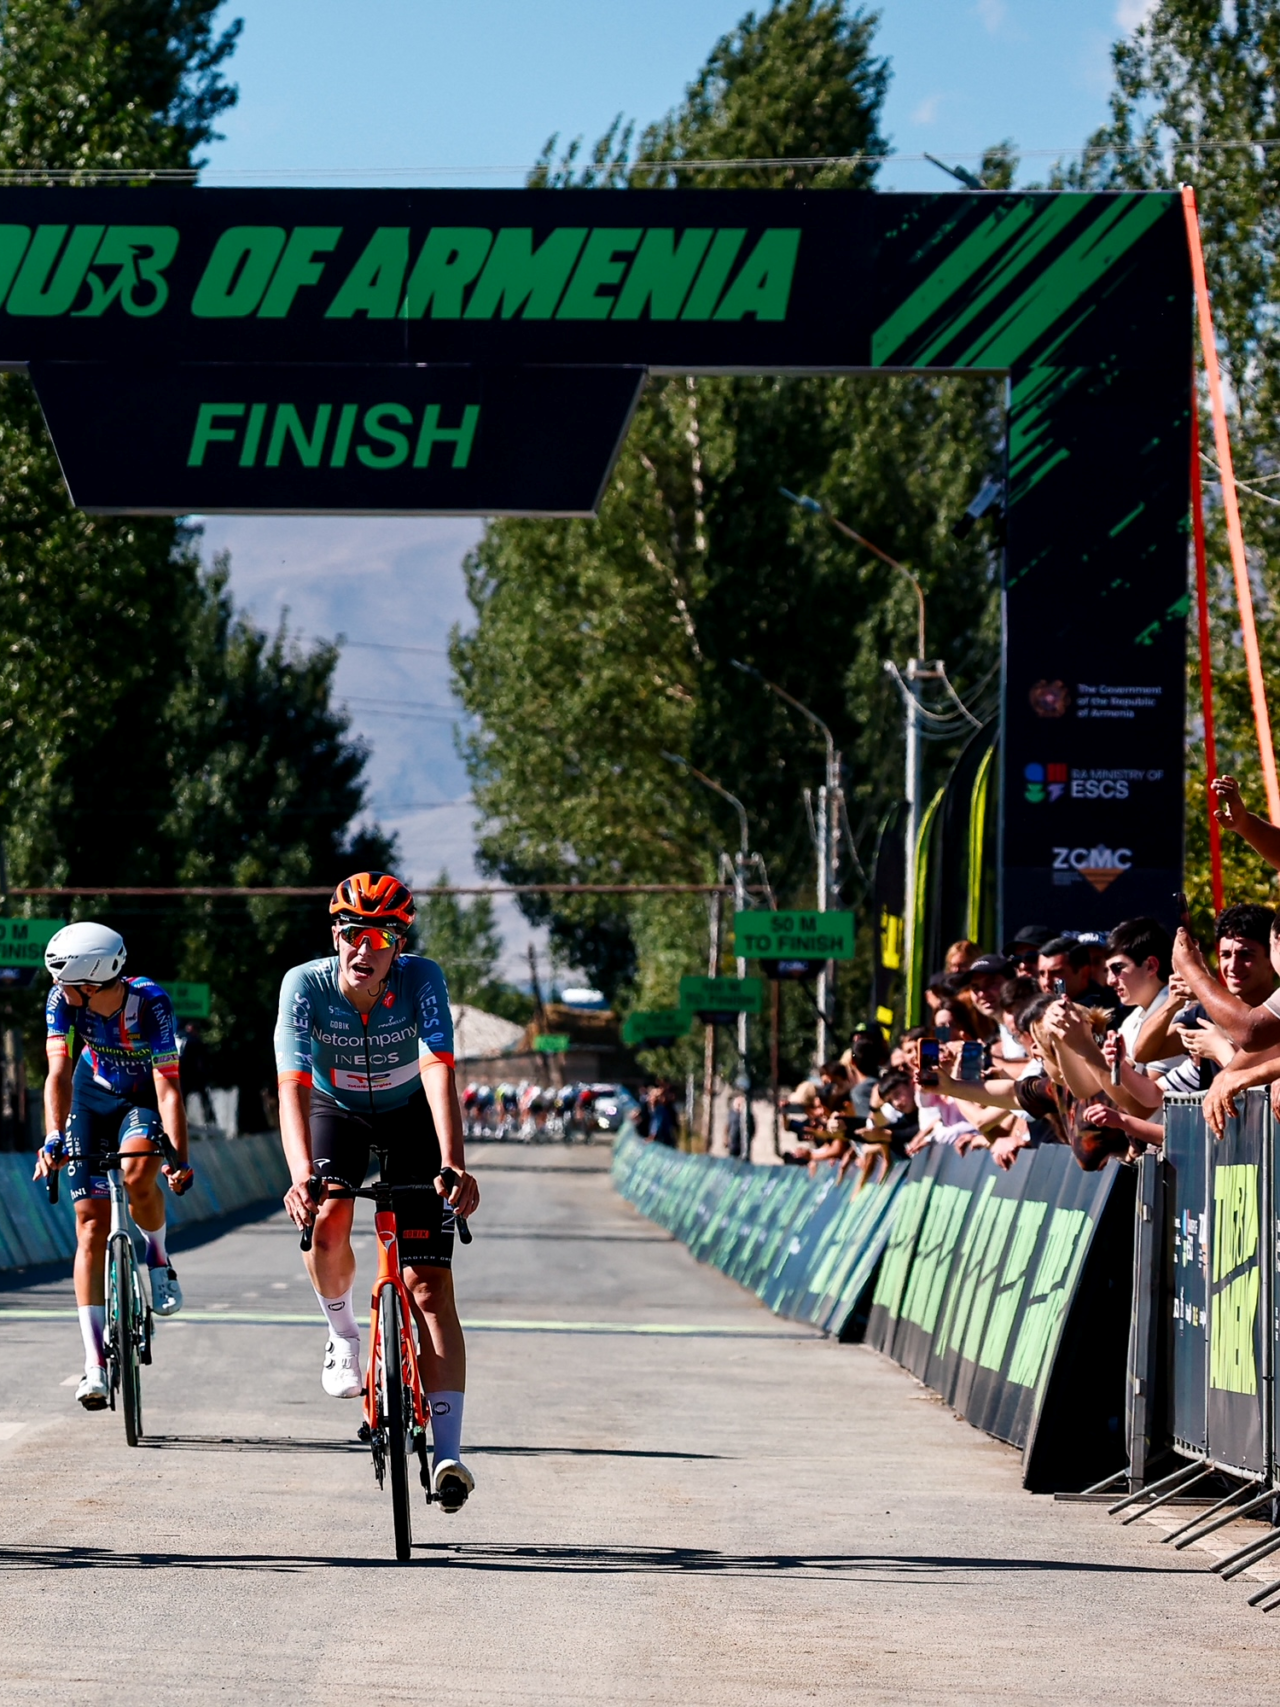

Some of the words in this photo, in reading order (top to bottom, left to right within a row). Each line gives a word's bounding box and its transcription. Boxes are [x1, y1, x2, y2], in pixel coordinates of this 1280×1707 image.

[191, 226, 342, 318] OF
[324, 228, 801, 321] ARMENIA
[187, 403, 480, 469] FINISH
[1090, 769, 1145, 779] MINISTRY
[1146, 769, 1164, 780] OF
[1072, 780, 1129, 799] ESCS
[1053, 848, 1132, 870] ZCMC
[12, 924, 28, 939] M
[772, 916, 794, 932] 50
[801, 916, 817, 932] M
[744, 935, 771, 951] TO
[777, 935, 844, 951] FINISH
[416, 981, 439, 1028] INEOS
[152, 1002, 170, 1044] FANTINI
[330, 1020, 350, 1030] GOBIK
[312, 1023, 417, 1047] Netcompany
[335, 1052, 399, 1065] INEOS
